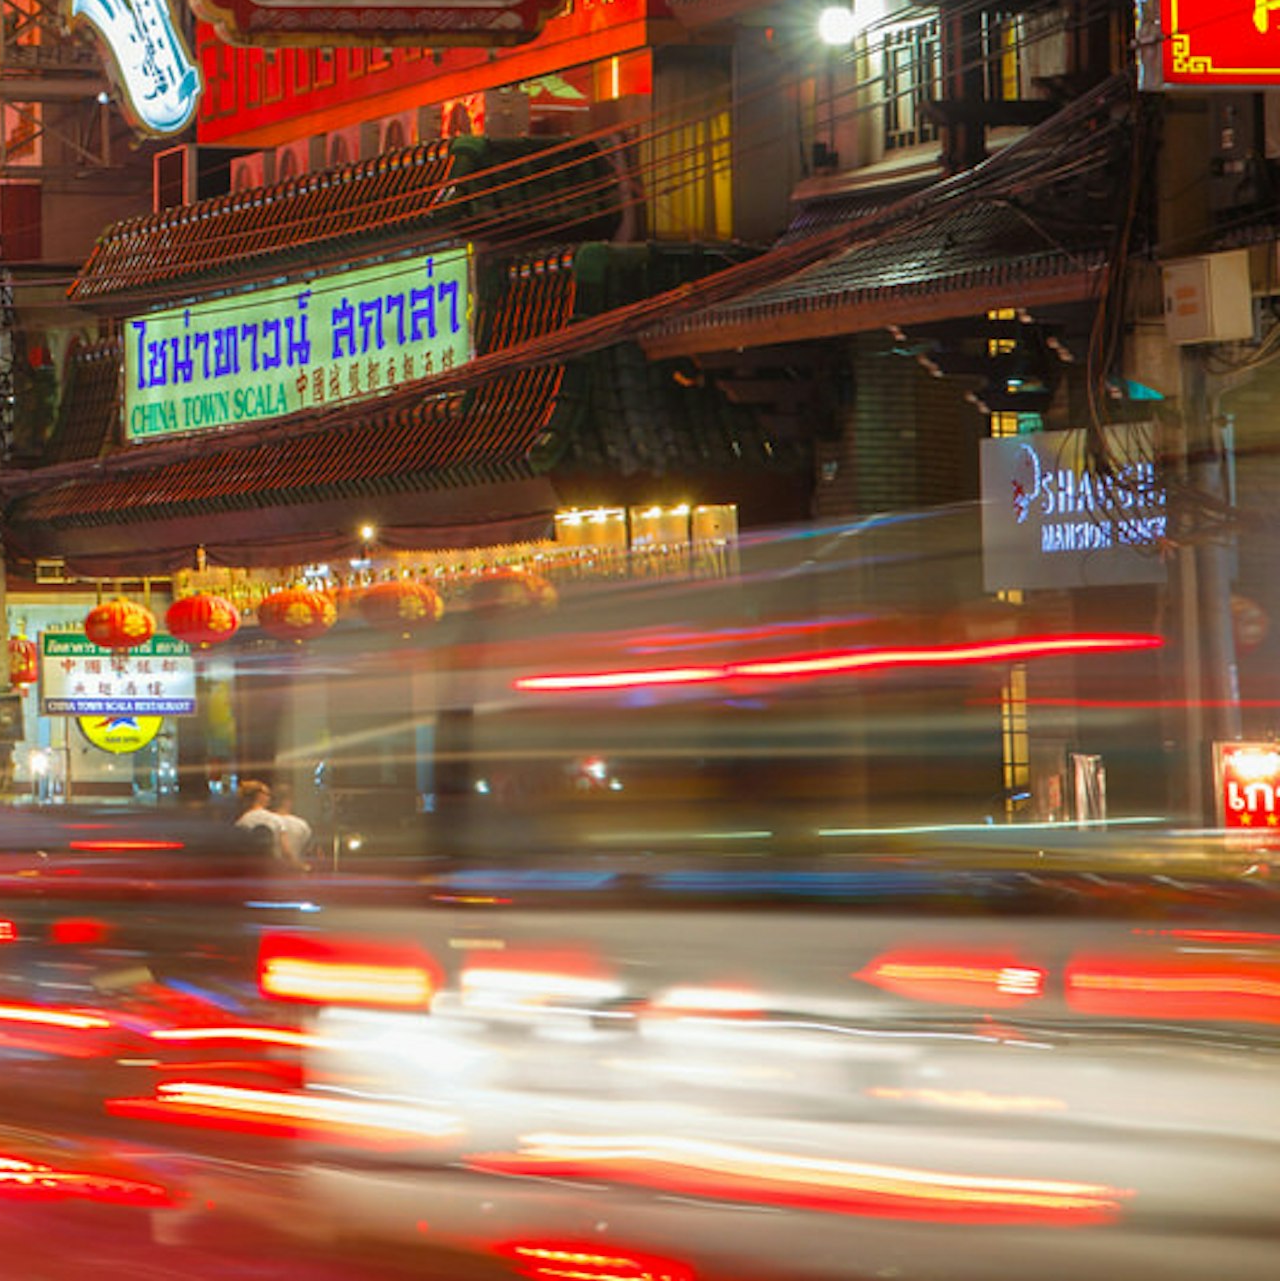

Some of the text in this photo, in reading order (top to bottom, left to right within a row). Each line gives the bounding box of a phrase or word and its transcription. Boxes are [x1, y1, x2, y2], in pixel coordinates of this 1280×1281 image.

[131, 257, 460, 391] ไชน่าทาวน์ สกาล่า
[131, 382, 288, 436] CHINA TOWN SCALA
[1228, 781, 1280, 813] เก
